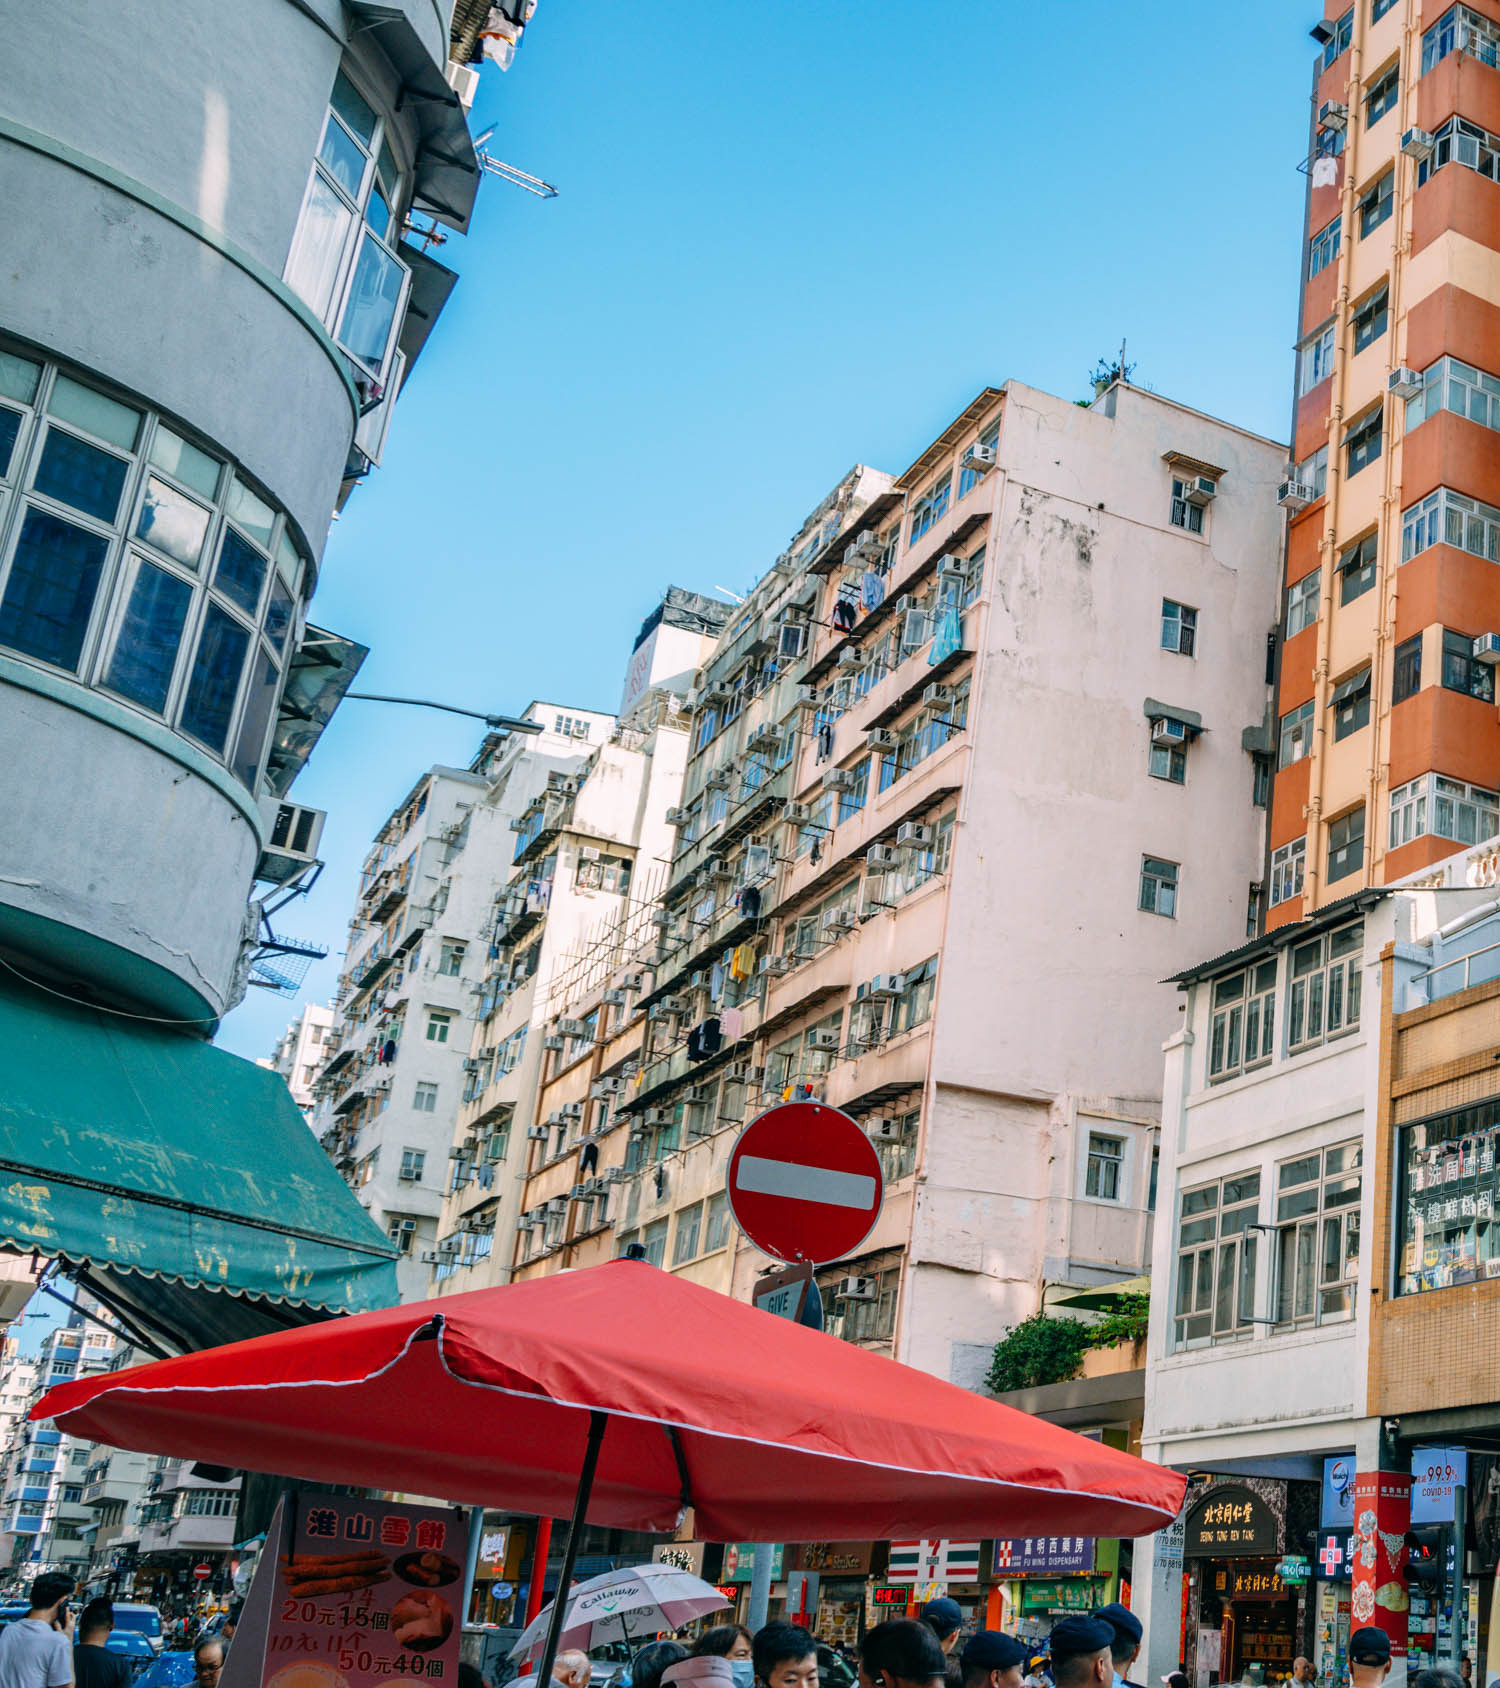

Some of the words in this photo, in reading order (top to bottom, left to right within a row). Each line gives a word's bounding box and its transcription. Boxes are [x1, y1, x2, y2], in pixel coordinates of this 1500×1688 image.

[768, 1291, 790, 1314] GIVE
[1422, 1487, 1452, 1497] COVID-19
[1203, 1502, 1254, 1525] 北京同仁堂
[1048, 1556, 1083, 1566] DISPENSARY
[1234, 1574, 1279, 1592] 北京同仁堂
[580, 1586, 640, 1609] Callaway
[339, 1650, 444, 1678] 50元40個
